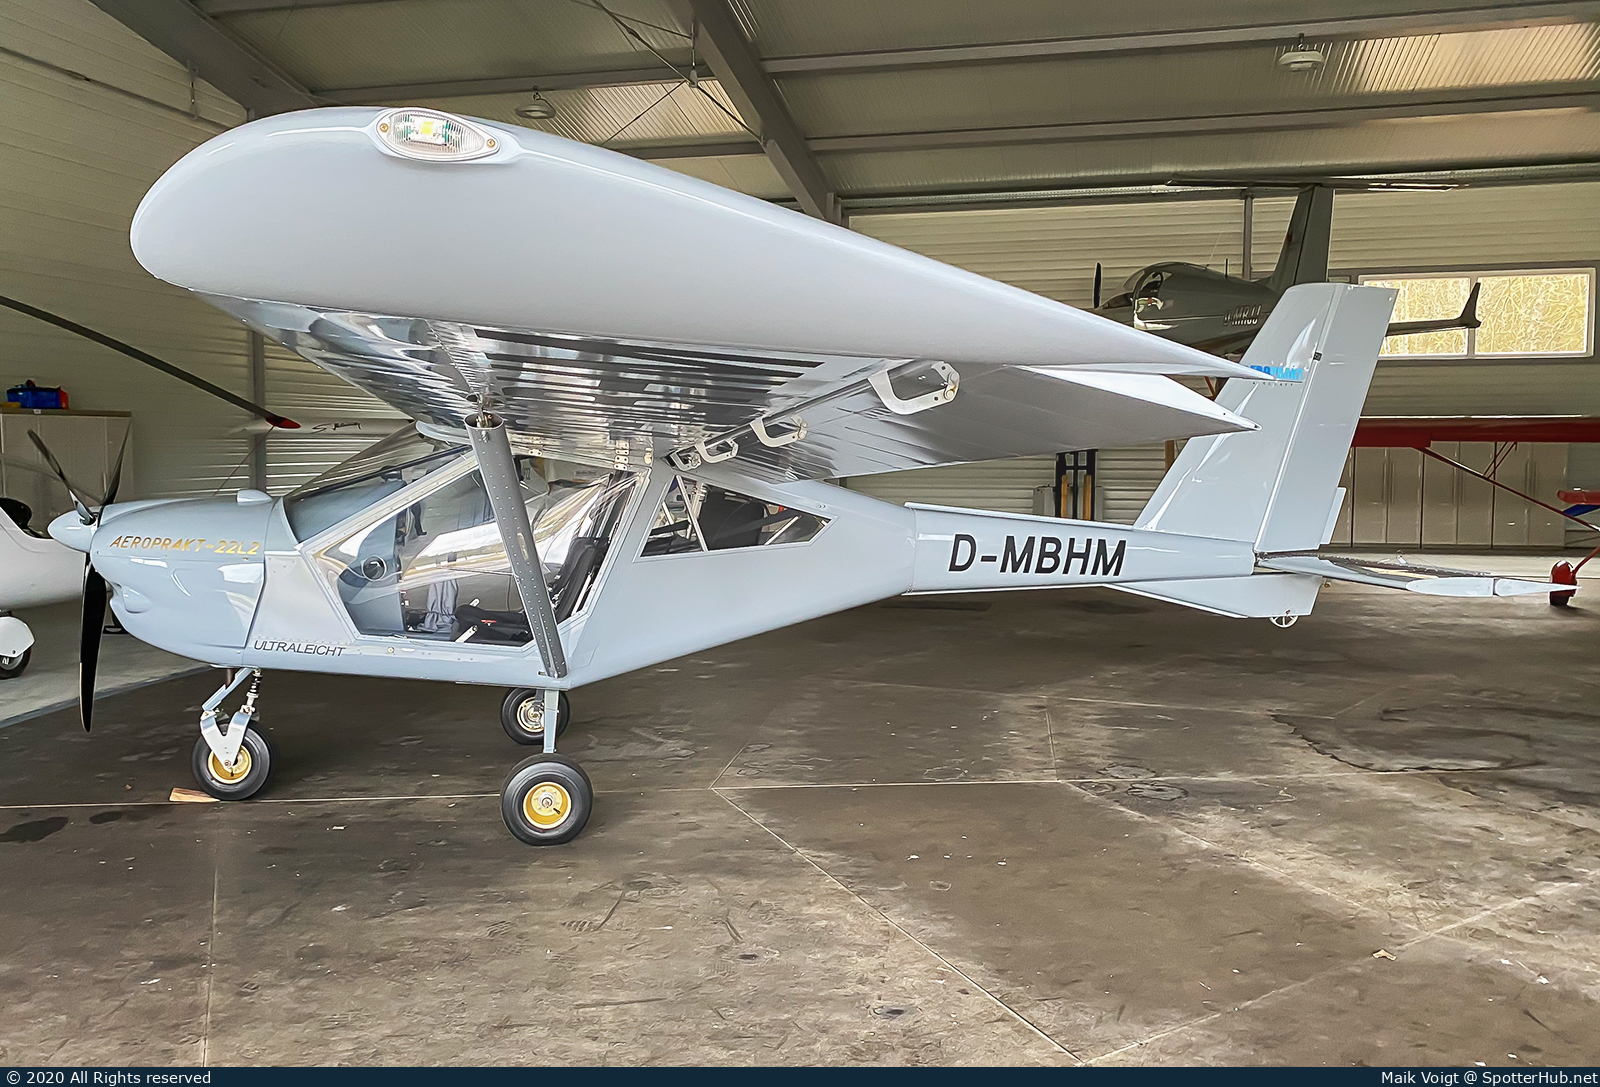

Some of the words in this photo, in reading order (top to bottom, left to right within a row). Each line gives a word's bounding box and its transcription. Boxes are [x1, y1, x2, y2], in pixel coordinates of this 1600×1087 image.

[109, 535, 260, 555] AEROPRAKT-22L2
[948, 533, 1127, 577] D-MBHM
[253, 640, 346, 657] ULTRALEICHT
